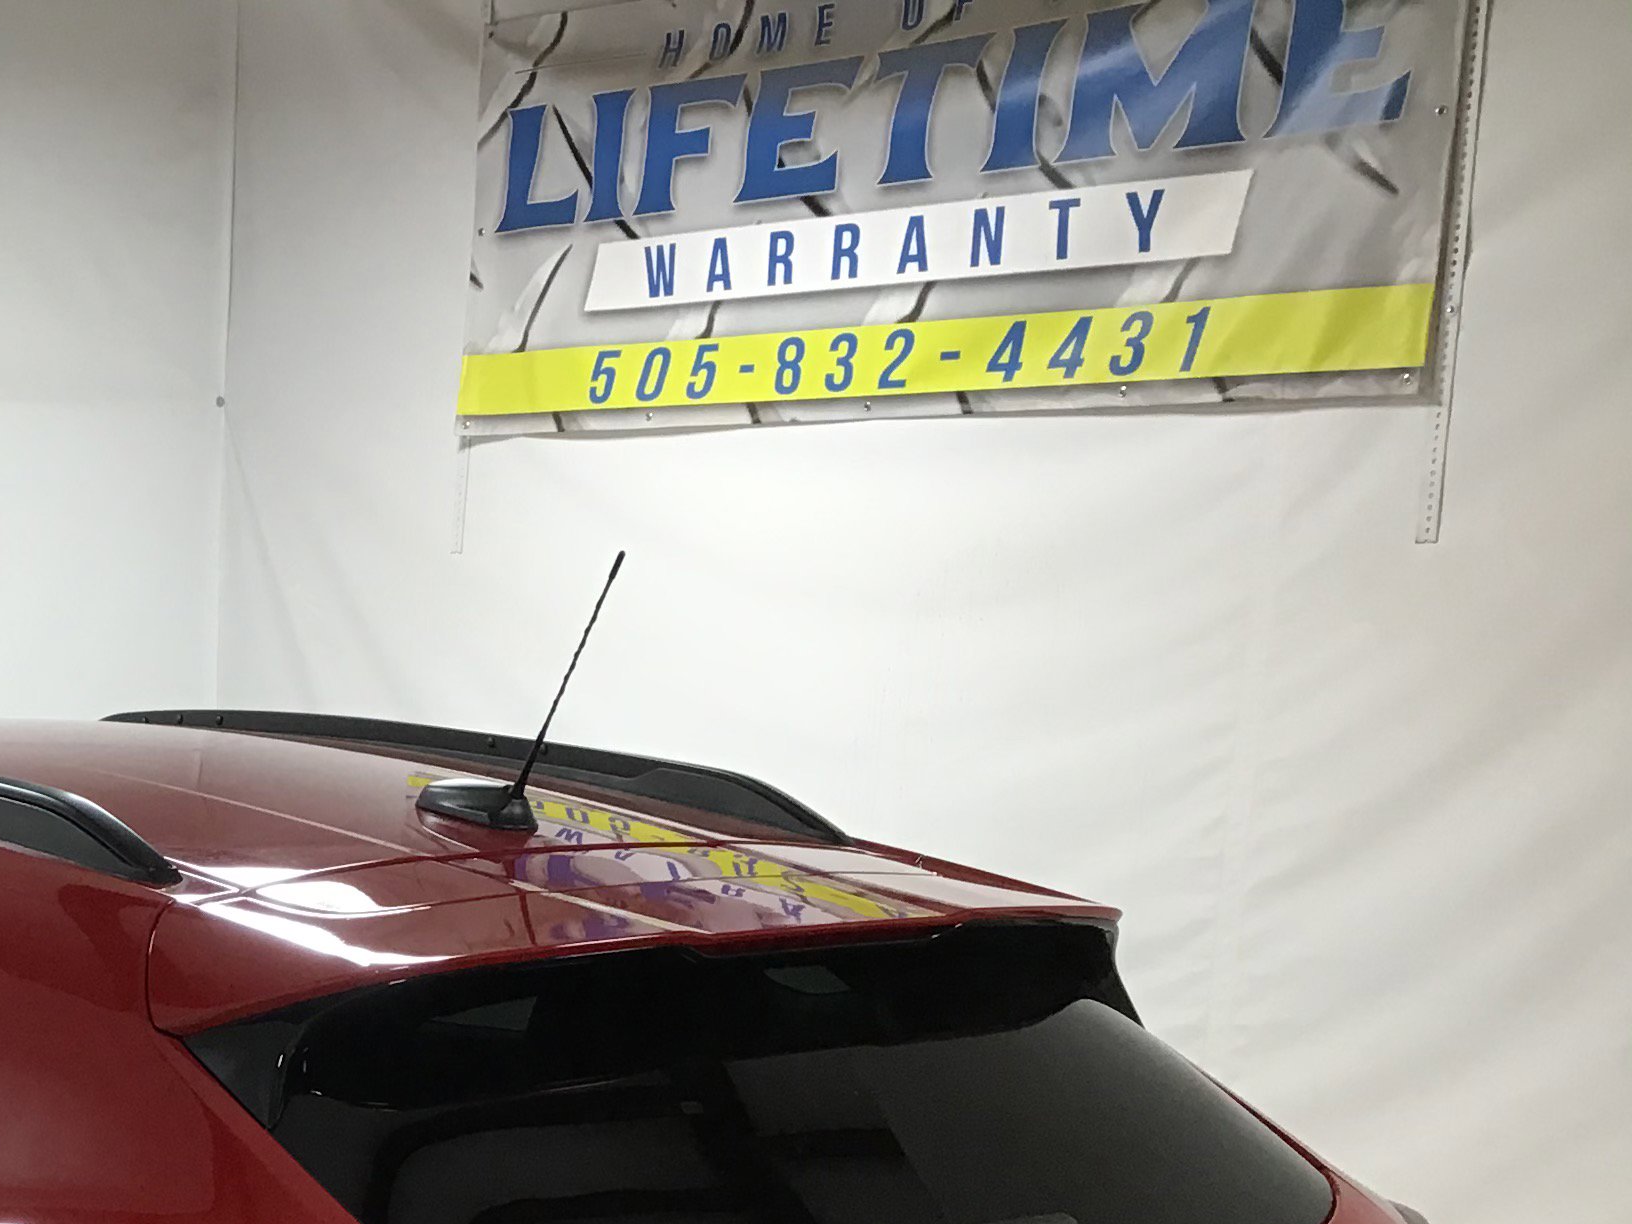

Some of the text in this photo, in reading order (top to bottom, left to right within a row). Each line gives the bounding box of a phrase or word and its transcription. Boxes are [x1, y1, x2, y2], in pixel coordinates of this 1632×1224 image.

[658, 2, 835, 69] HOME
[495, 0, 1412, 233] LIFETIME
[644, 189, 1165, 298] WARRANTY
[589, 306, 1211, 404] 505-832-4431
